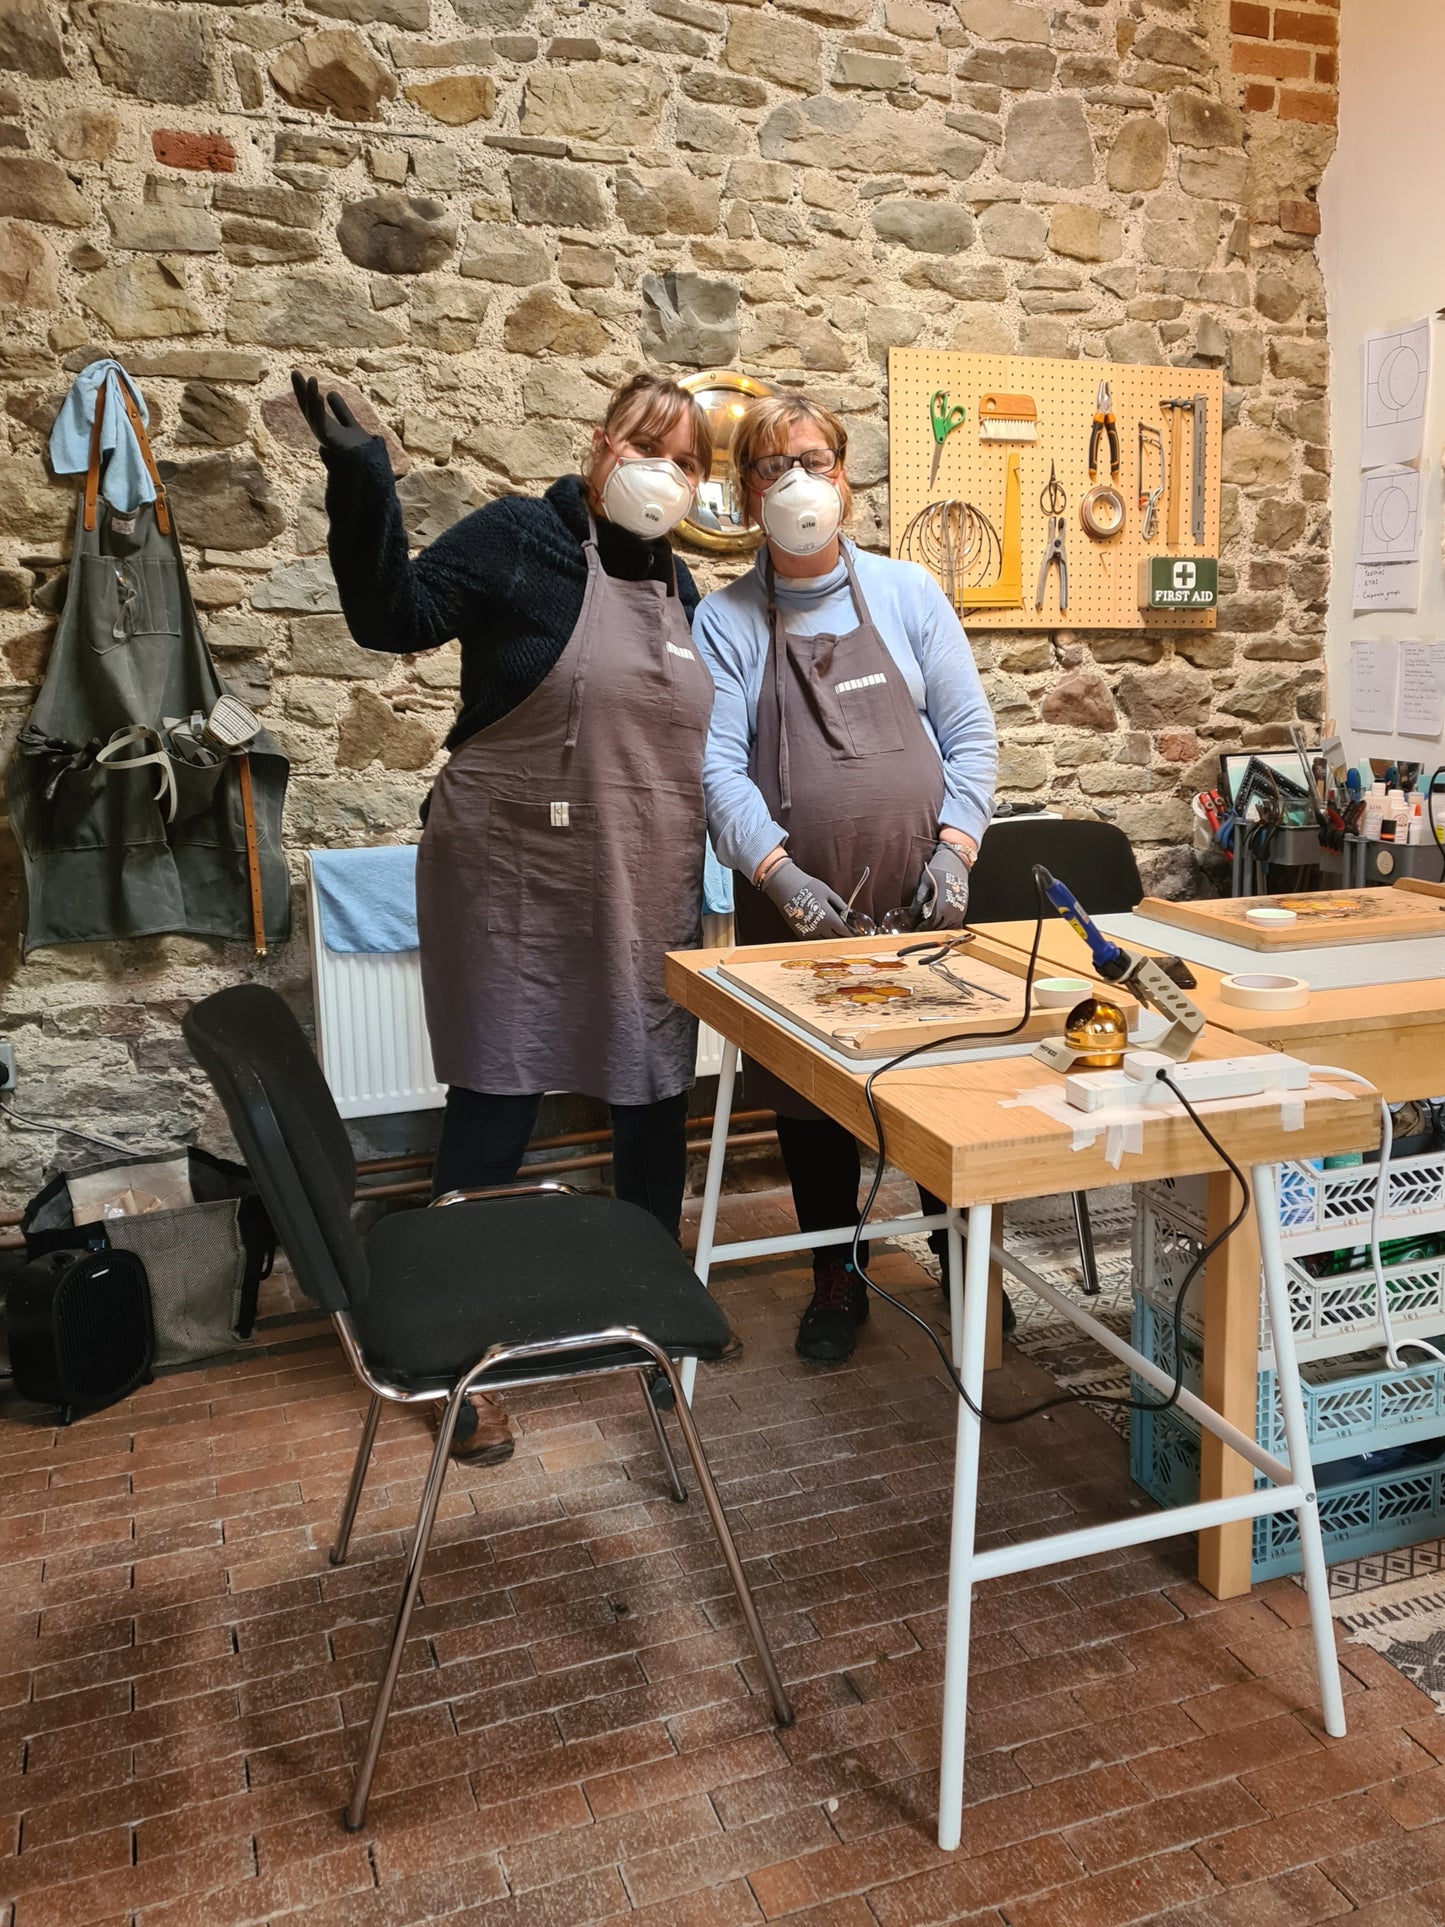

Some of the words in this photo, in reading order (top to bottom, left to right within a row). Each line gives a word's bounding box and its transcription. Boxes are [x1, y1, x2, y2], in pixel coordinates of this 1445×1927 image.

[1154, 589, 1190, 602] FIRST
[1191, 590, 1214, 602] AID
[800, 908, 826, 934] MaxiFlex
